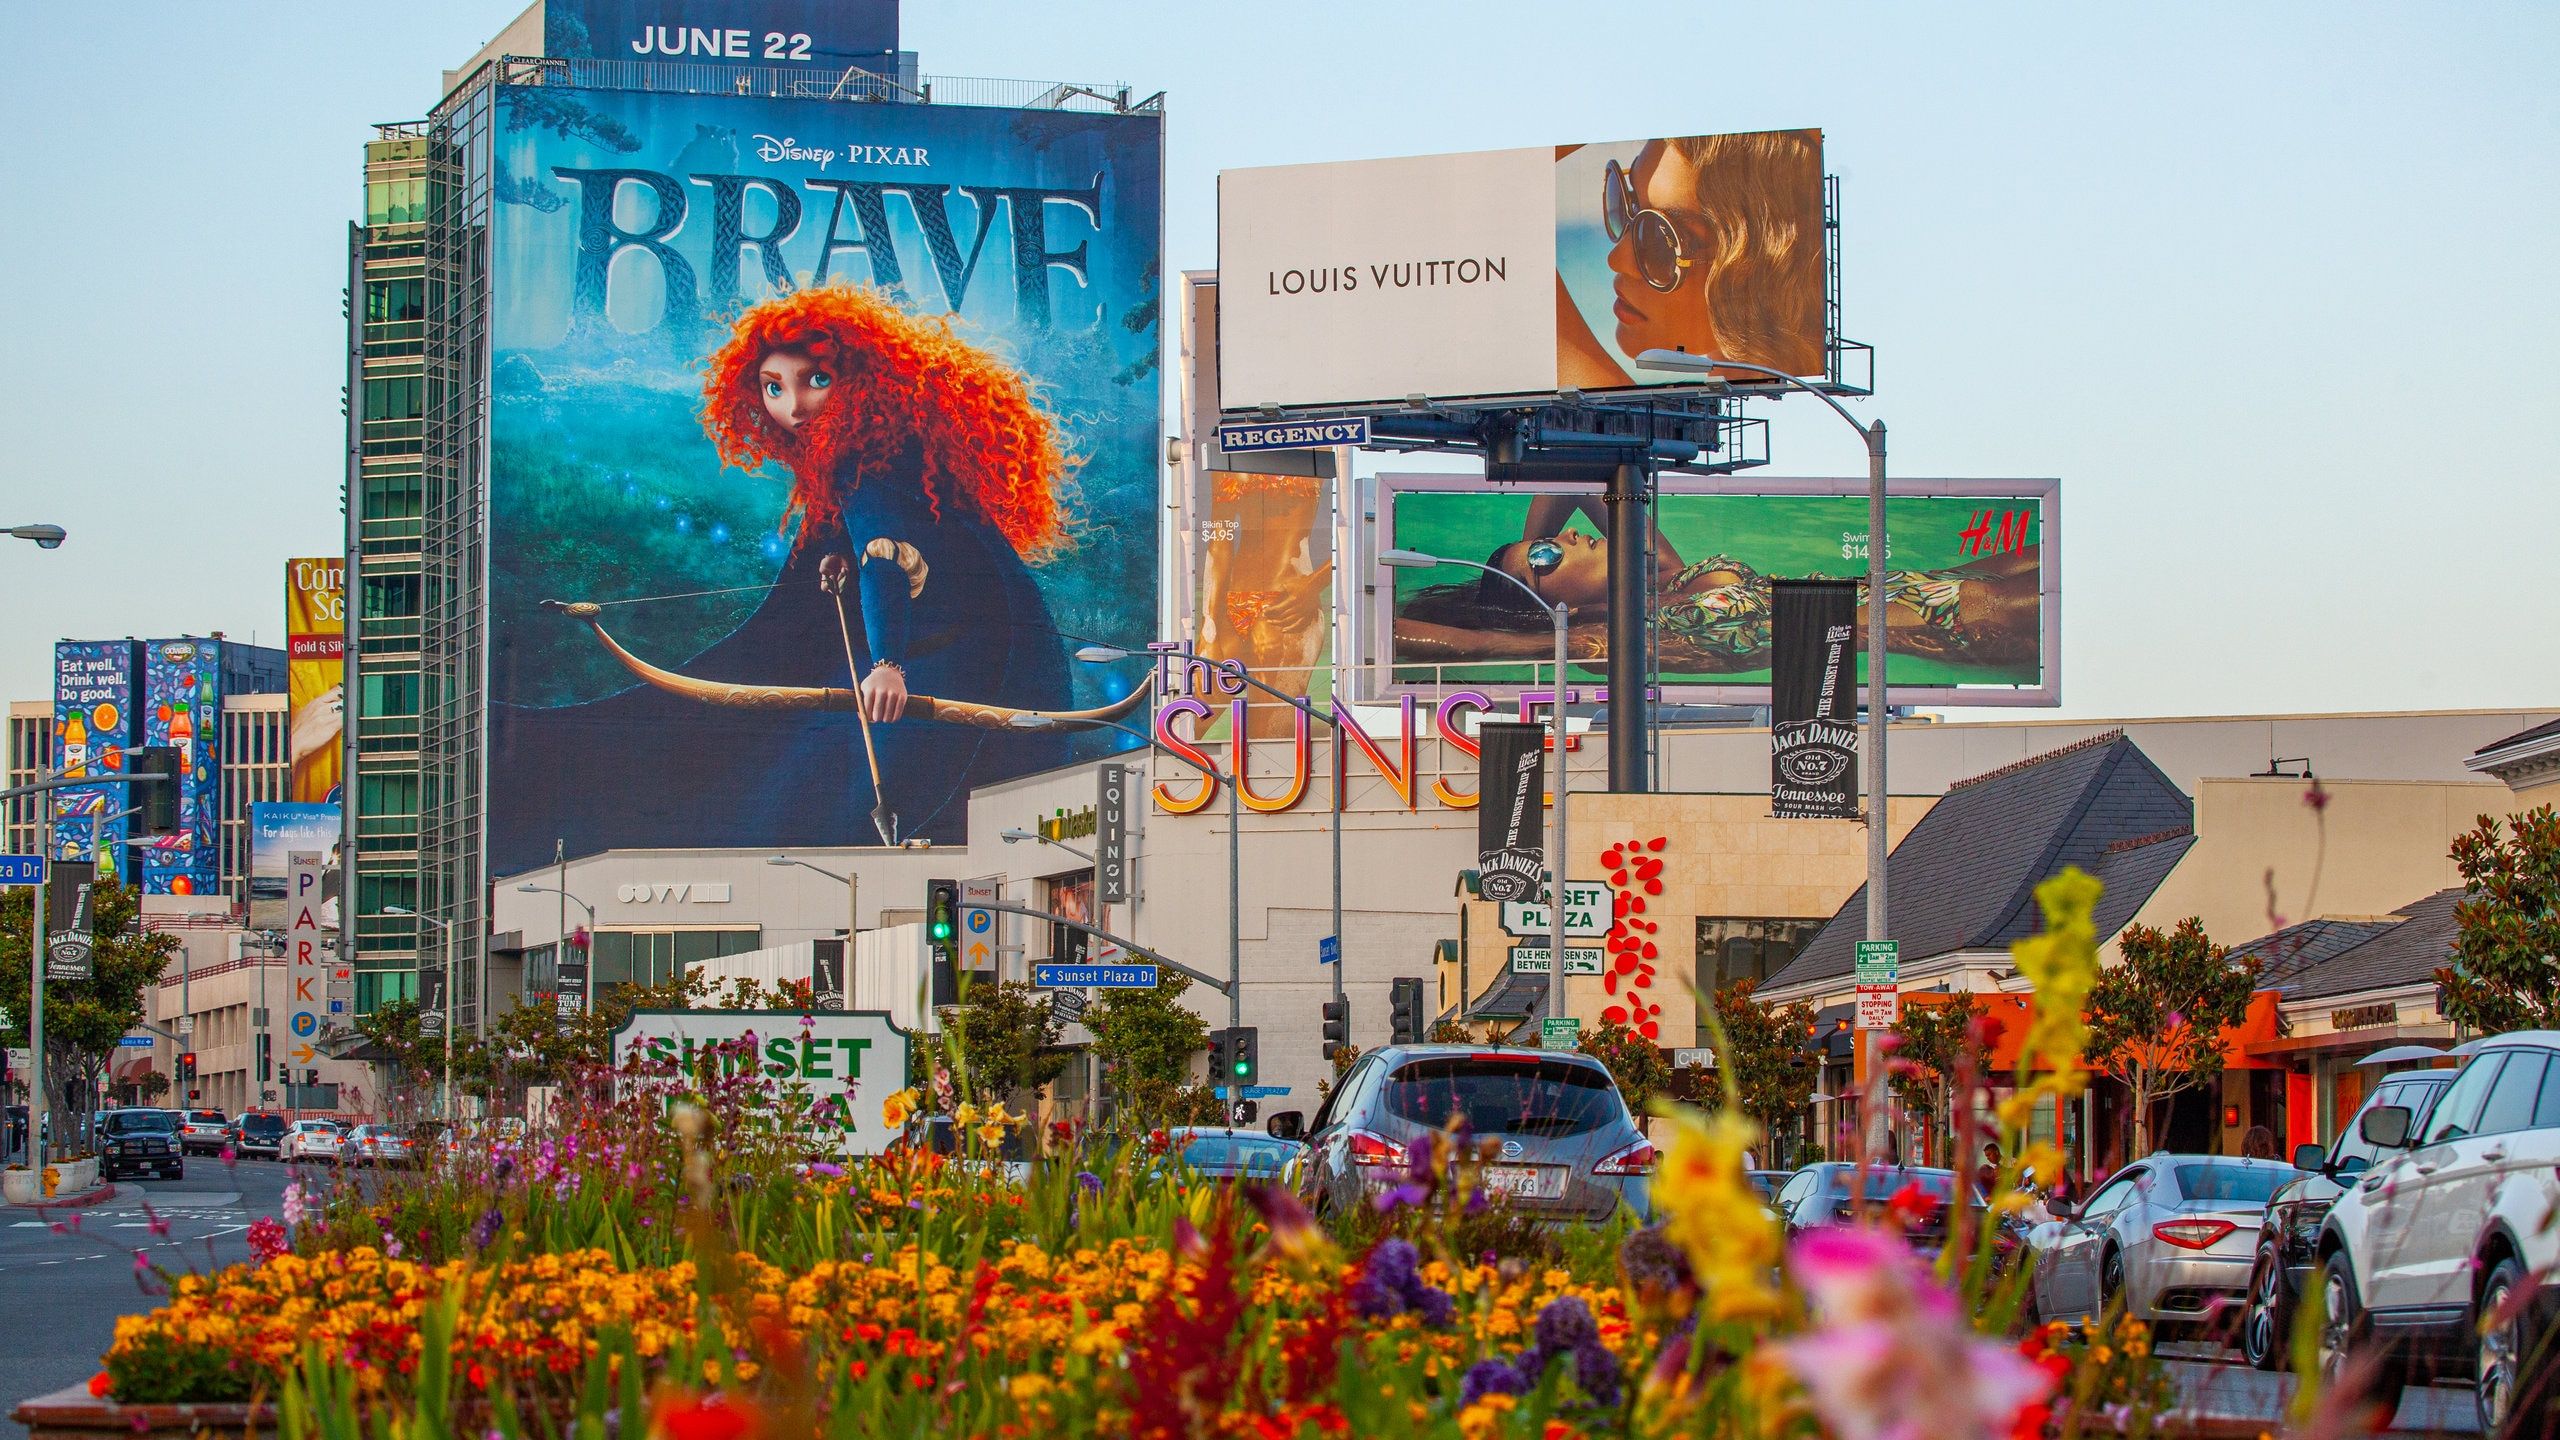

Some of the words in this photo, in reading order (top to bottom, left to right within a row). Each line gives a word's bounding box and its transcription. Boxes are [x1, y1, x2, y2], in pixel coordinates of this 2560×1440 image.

[632, 26, 750, 57] JUNE
[764, 32, 812, 60] 22
[848, 145, 931, 167] PIXAR
[551, 166, 1103, 335] BRAVE
[1269, 266, 1358, 295] LOUIS
[1370, 256, 1506, 290] VUITTON
[1224, 423, 1362, 448] REGENCY
[1202, 521, 1222, 529] Bikini
[1224, 520, 1239, 530] Top
[1958, 510, 2031, 557] H&M
[1202, 530, 1234, 543] $4.95
[1842, 532, 1890, 543] Swimt
[1842, 543, 1891, 560] $145
[294, 641, 316, 655] Gold
[319, 642, 326, 654] &
[1828, 643, 1842, 665] STRIP
[61, 660, 82, 672] Eat
[86, 658, 116, 671] well.
[1148, 640, 1249, 696] The
[61, 674, 94, 686] Drink
[97, 672, 127, 685] well.
[1821, 665, 1838, 697] SUNSET
[61, 689, 78, 700] Do
[81, 688, 116, 702] good.
[1816, 698, 1832, 718] THE
[1772, 728, 1807, 756] JACK
[1796, 760, 1828, 771] No.7
[1517, 772, 1530, 795] STRIP
[1772, 783, 1846, 804] Tennessee
[1510, 795, 1525, 828] SUNSET
[263, 825, 277, 838] For
[280, 825, 298, 842] days
[300, 825, 312, 838] like
[1106, 770, 1120, 895] EQUINOX
[1506, 828, 1519, 848] THE
[22, 863, 39, 878] Dr
[1478, 857, 1499, 879] JACK
[974, 913, 987, 929] P
[1523, 911, 1594, 928] PLZA
[294, 873, 317, 1002] PARK
[1517, 950, 1532, 960] OLE
[1535, 950, 1581, 960] HENSEN
[1582, 951, 1598, 961] SPA
[1861, 943, 1893, 952] PARKING
[1517, 961, 1551, 970] BETWEE
[1057, 970, 1098, 982] Sunset
[1103, 970, 1135, 983] Plaza
[1141, 970, 1154, 982] Dr
[1861, 1000, 1893, 1008] STOPPING
[298, 1015, 312, 1033] P
